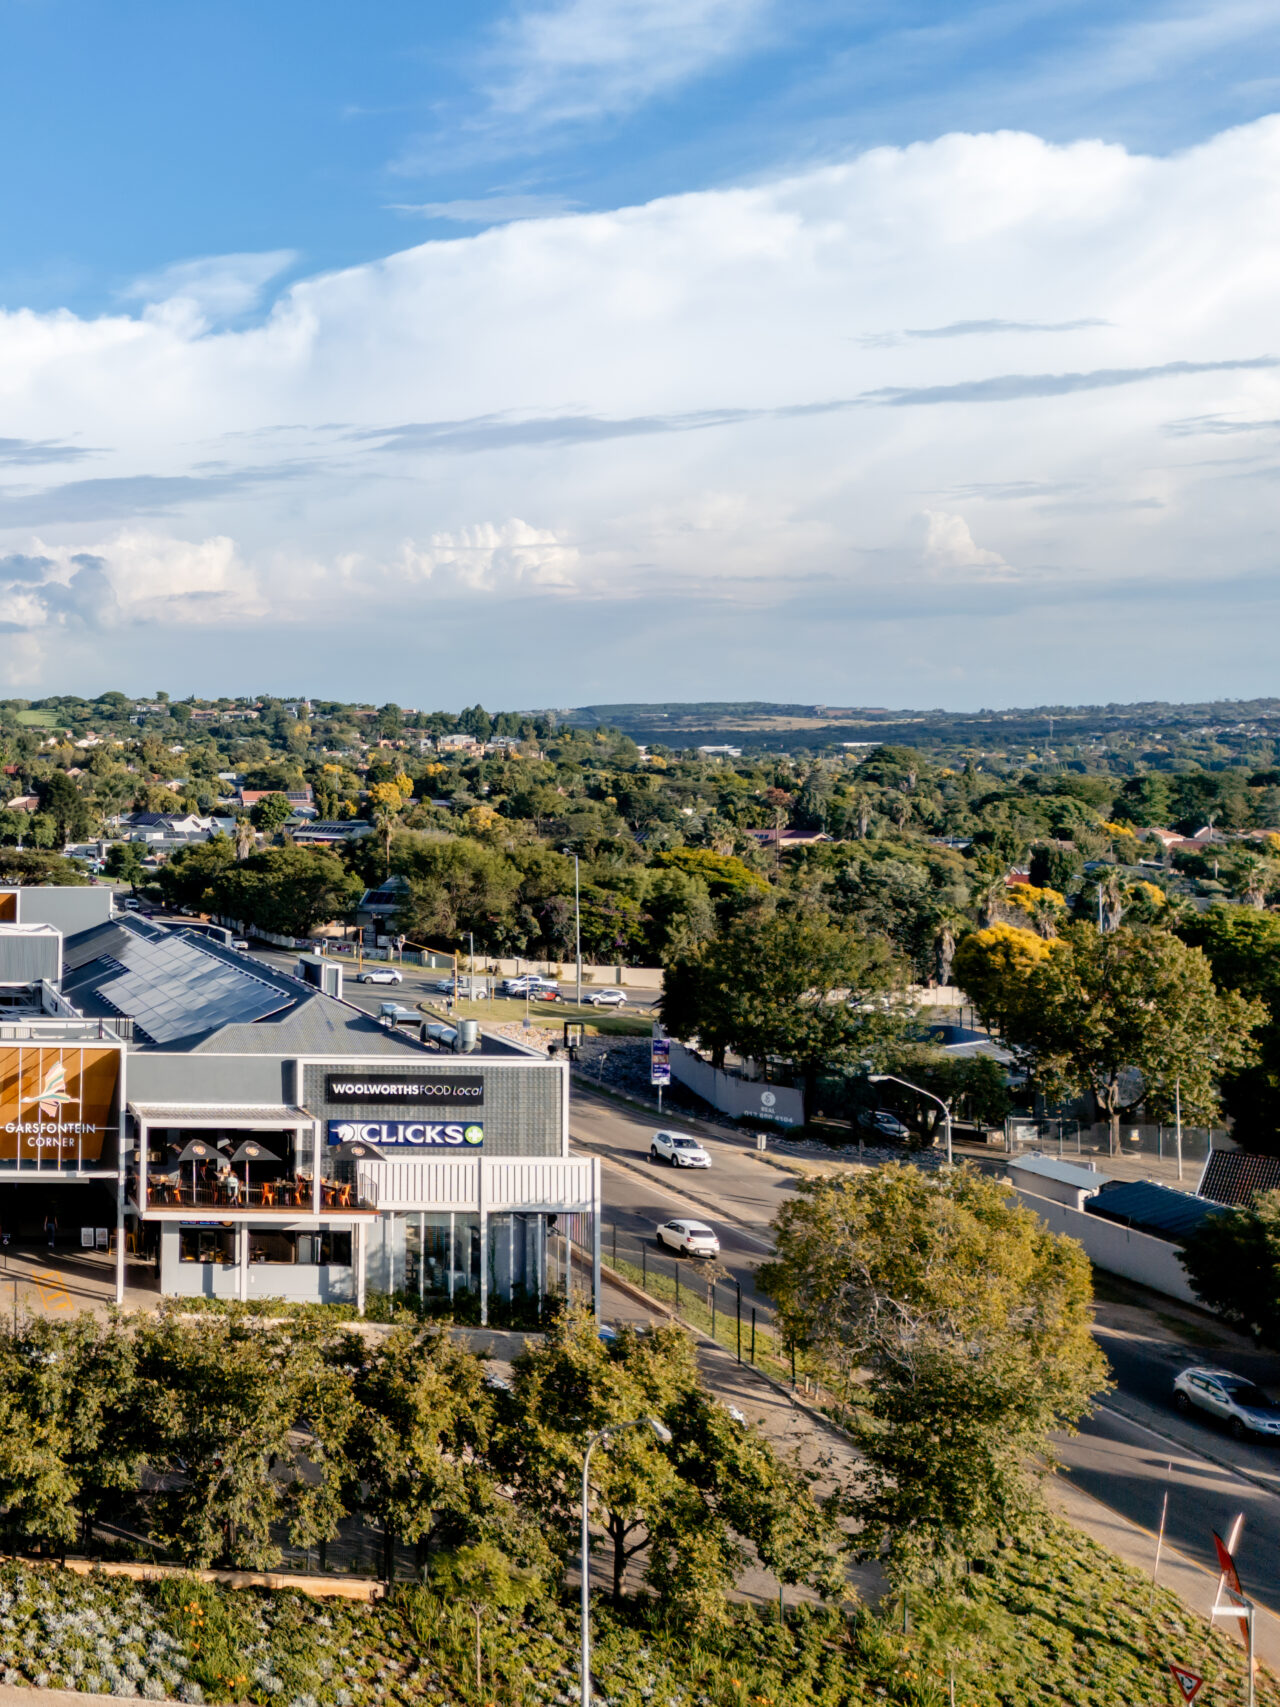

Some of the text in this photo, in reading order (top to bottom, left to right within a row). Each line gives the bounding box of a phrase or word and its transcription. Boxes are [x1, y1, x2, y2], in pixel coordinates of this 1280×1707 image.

[332, 1083, 419, 1095] WOOLWORTHS
[5, 1122, 96, 1134] GARSFONTEIN
[361, 1124, 464, 1144] CLICKS
[27, 1137, 75, 1147] CORNER
